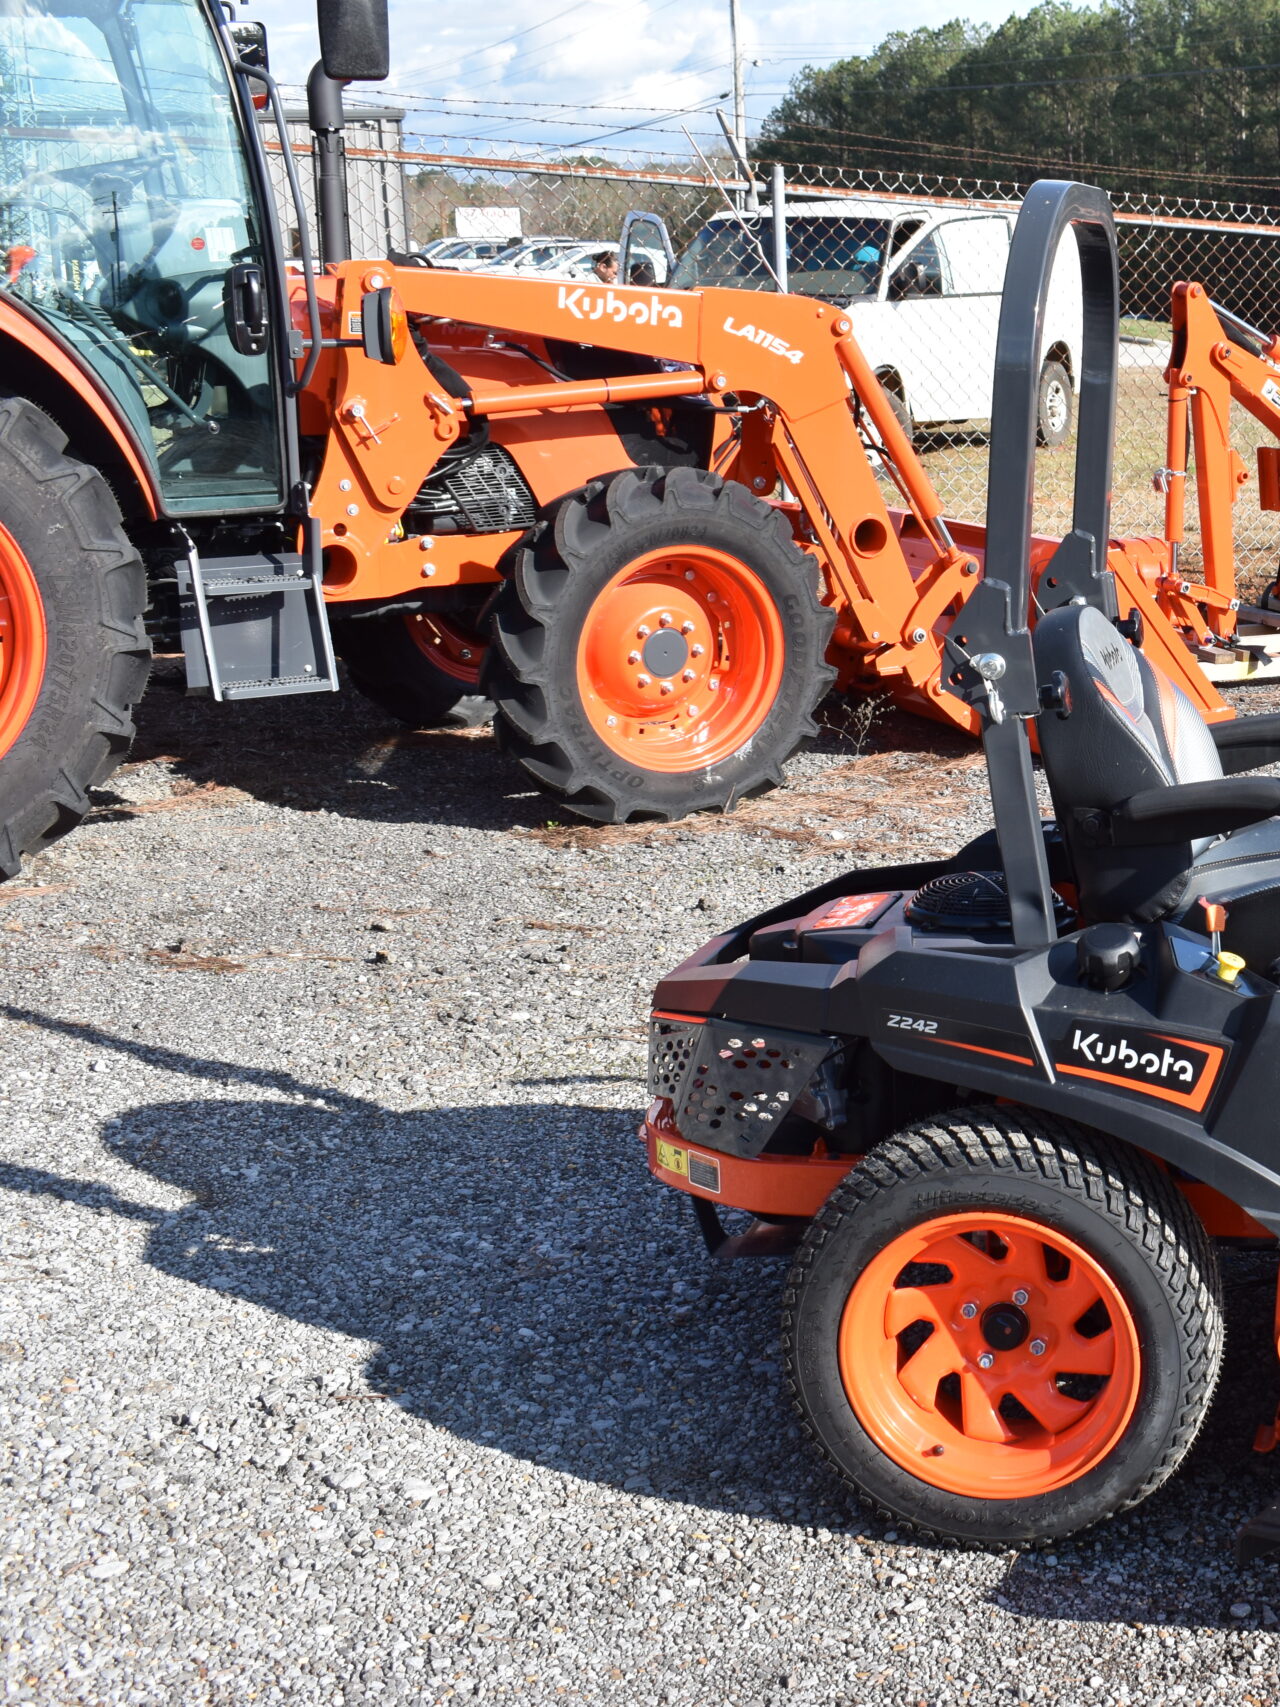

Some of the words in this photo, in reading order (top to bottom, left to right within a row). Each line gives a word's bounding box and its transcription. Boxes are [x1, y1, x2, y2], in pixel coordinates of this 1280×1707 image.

[558, 286, 683, 328] Kubota
[723, 316, 804, 364] LA1154
[887, 1014, 938, 1034] Z242
[1072, 1029, 1194, 1082] Kubota
